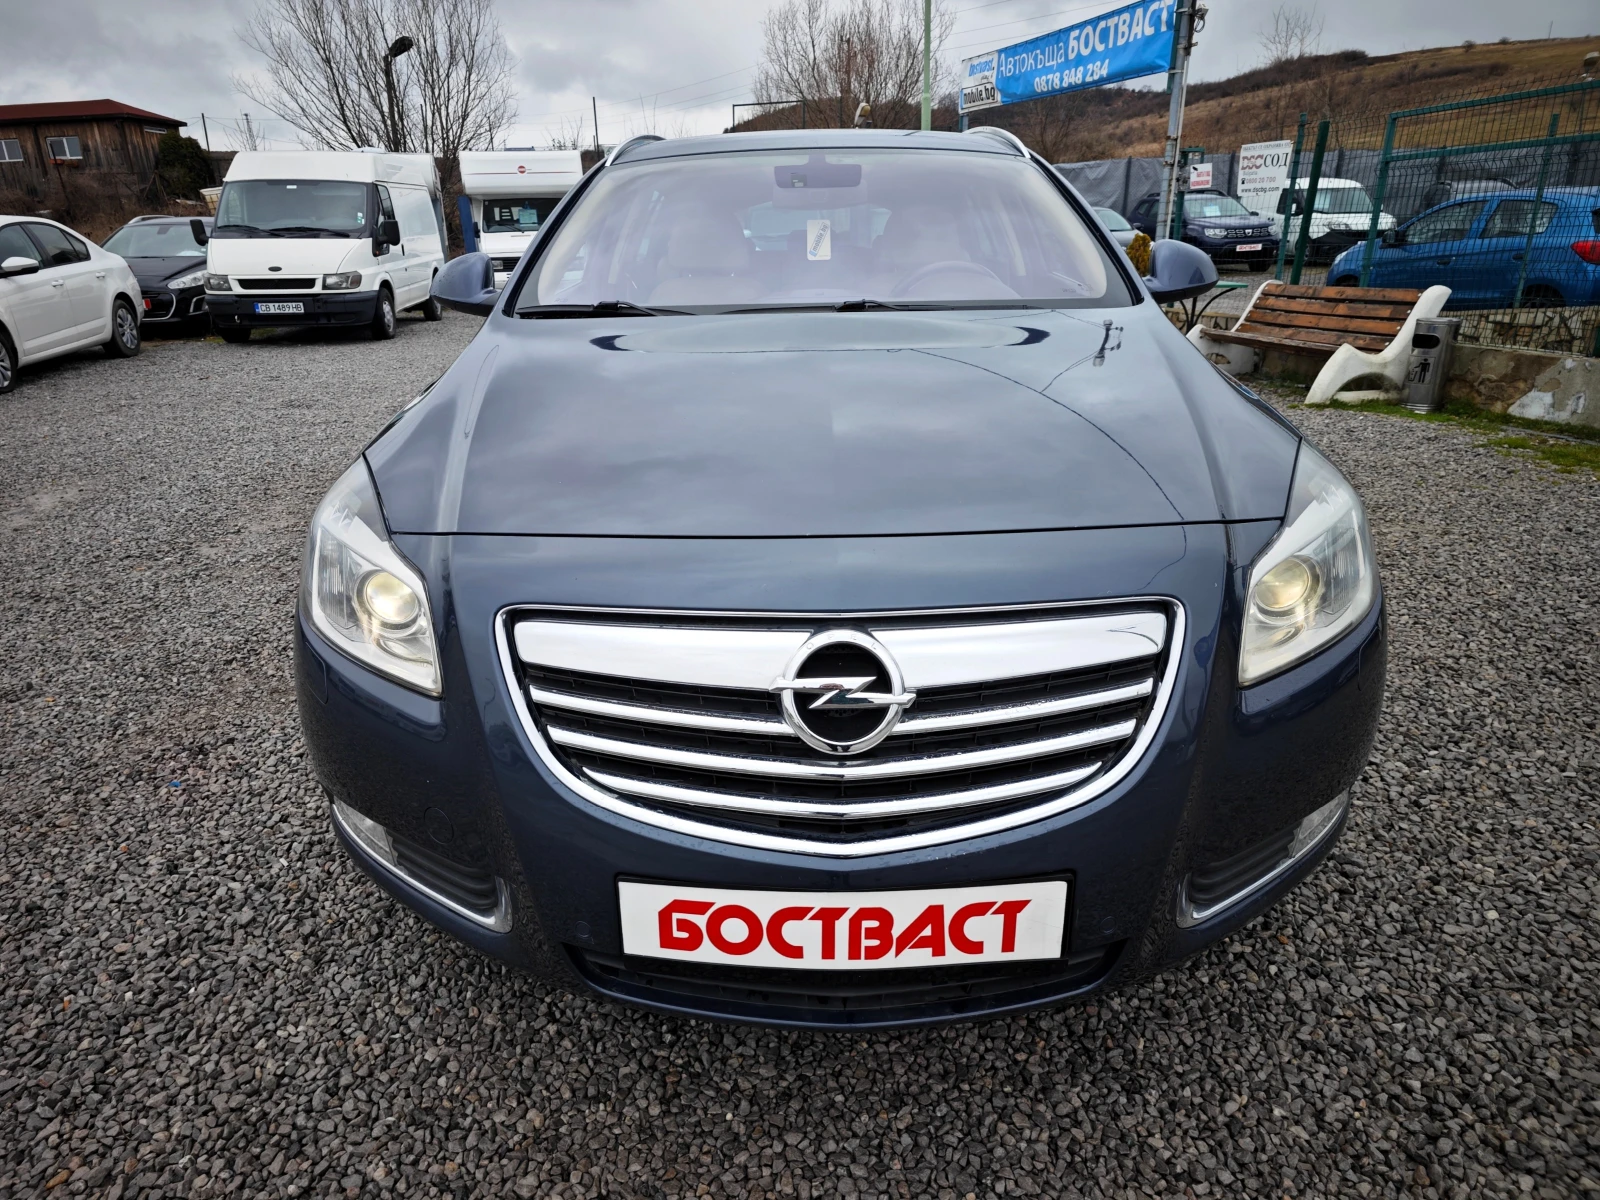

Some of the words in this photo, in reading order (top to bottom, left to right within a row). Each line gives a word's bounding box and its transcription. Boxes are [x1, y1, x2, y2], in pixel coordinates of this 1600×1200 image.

[998, 42, 1065, 79] Автокъща
[1067, 0, 1173, 60] БОСТВАСТ
[1034, 72, 1061, 93] 0878
[1062, 65, 1084, 88] 848
[1085, 58, 1110, 82] 284
[1263, 152, 1289, 168] СОД
[805, 633, 877, 650] OPEL
[658, 899, 1033, 961] БОСТВАСТ
